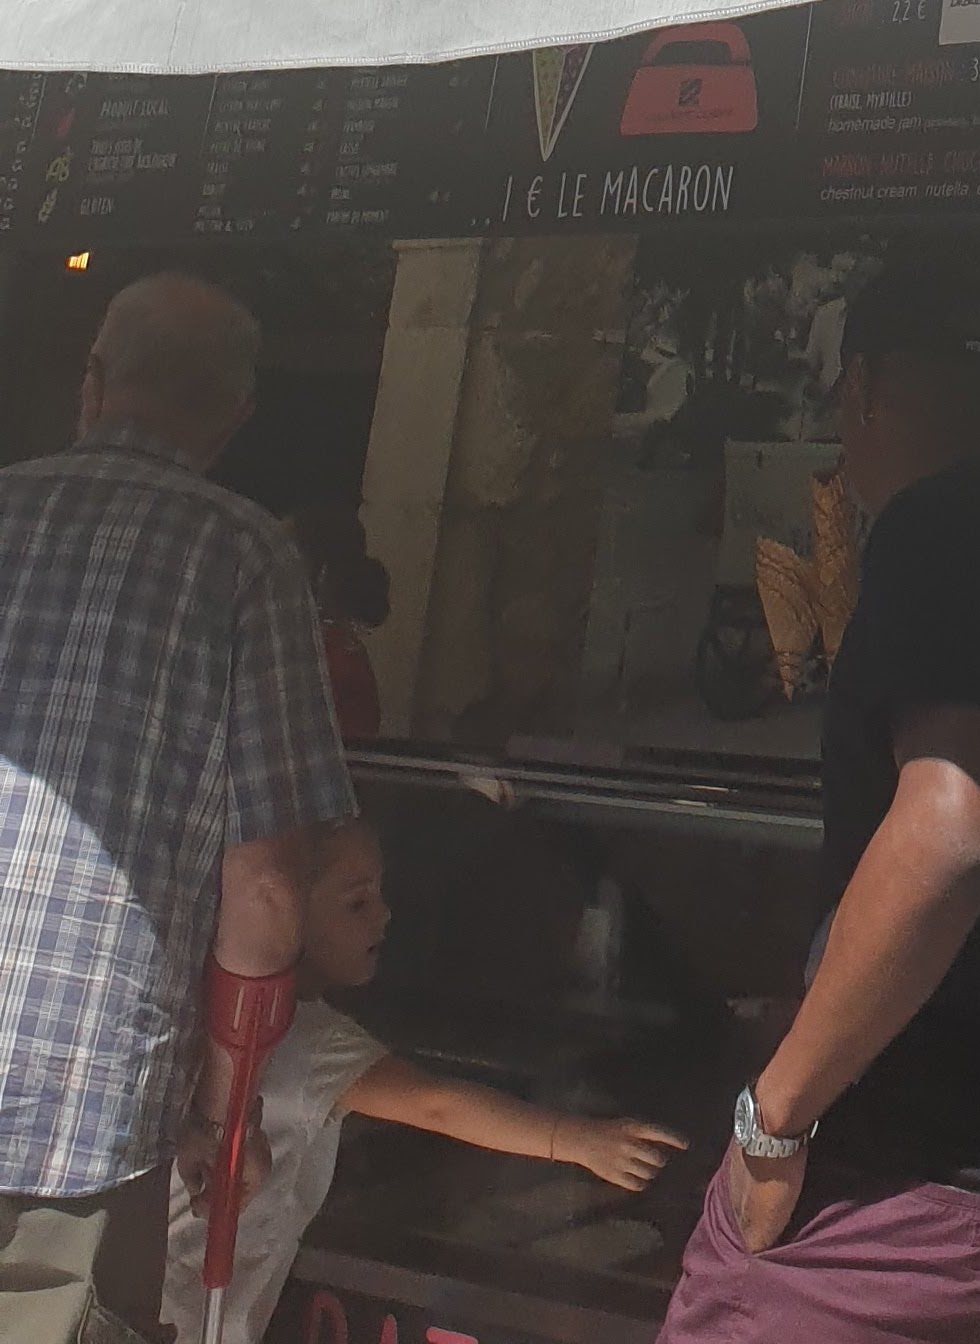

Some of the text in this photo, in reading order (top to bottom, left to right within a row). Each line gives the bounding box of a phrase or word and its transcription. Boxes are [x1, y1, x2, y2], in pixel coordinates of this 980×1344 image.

[827, 115, 896, 133] homemade
[527, 175, 543, 218] €
[557, 172, 587, 218] LE
[600, 164, 734, 215] MACARON
[820, 184, 875, 201] chestnut
[877, 186, 917, 200] cream
[925, 181, 969, 197] nutella
